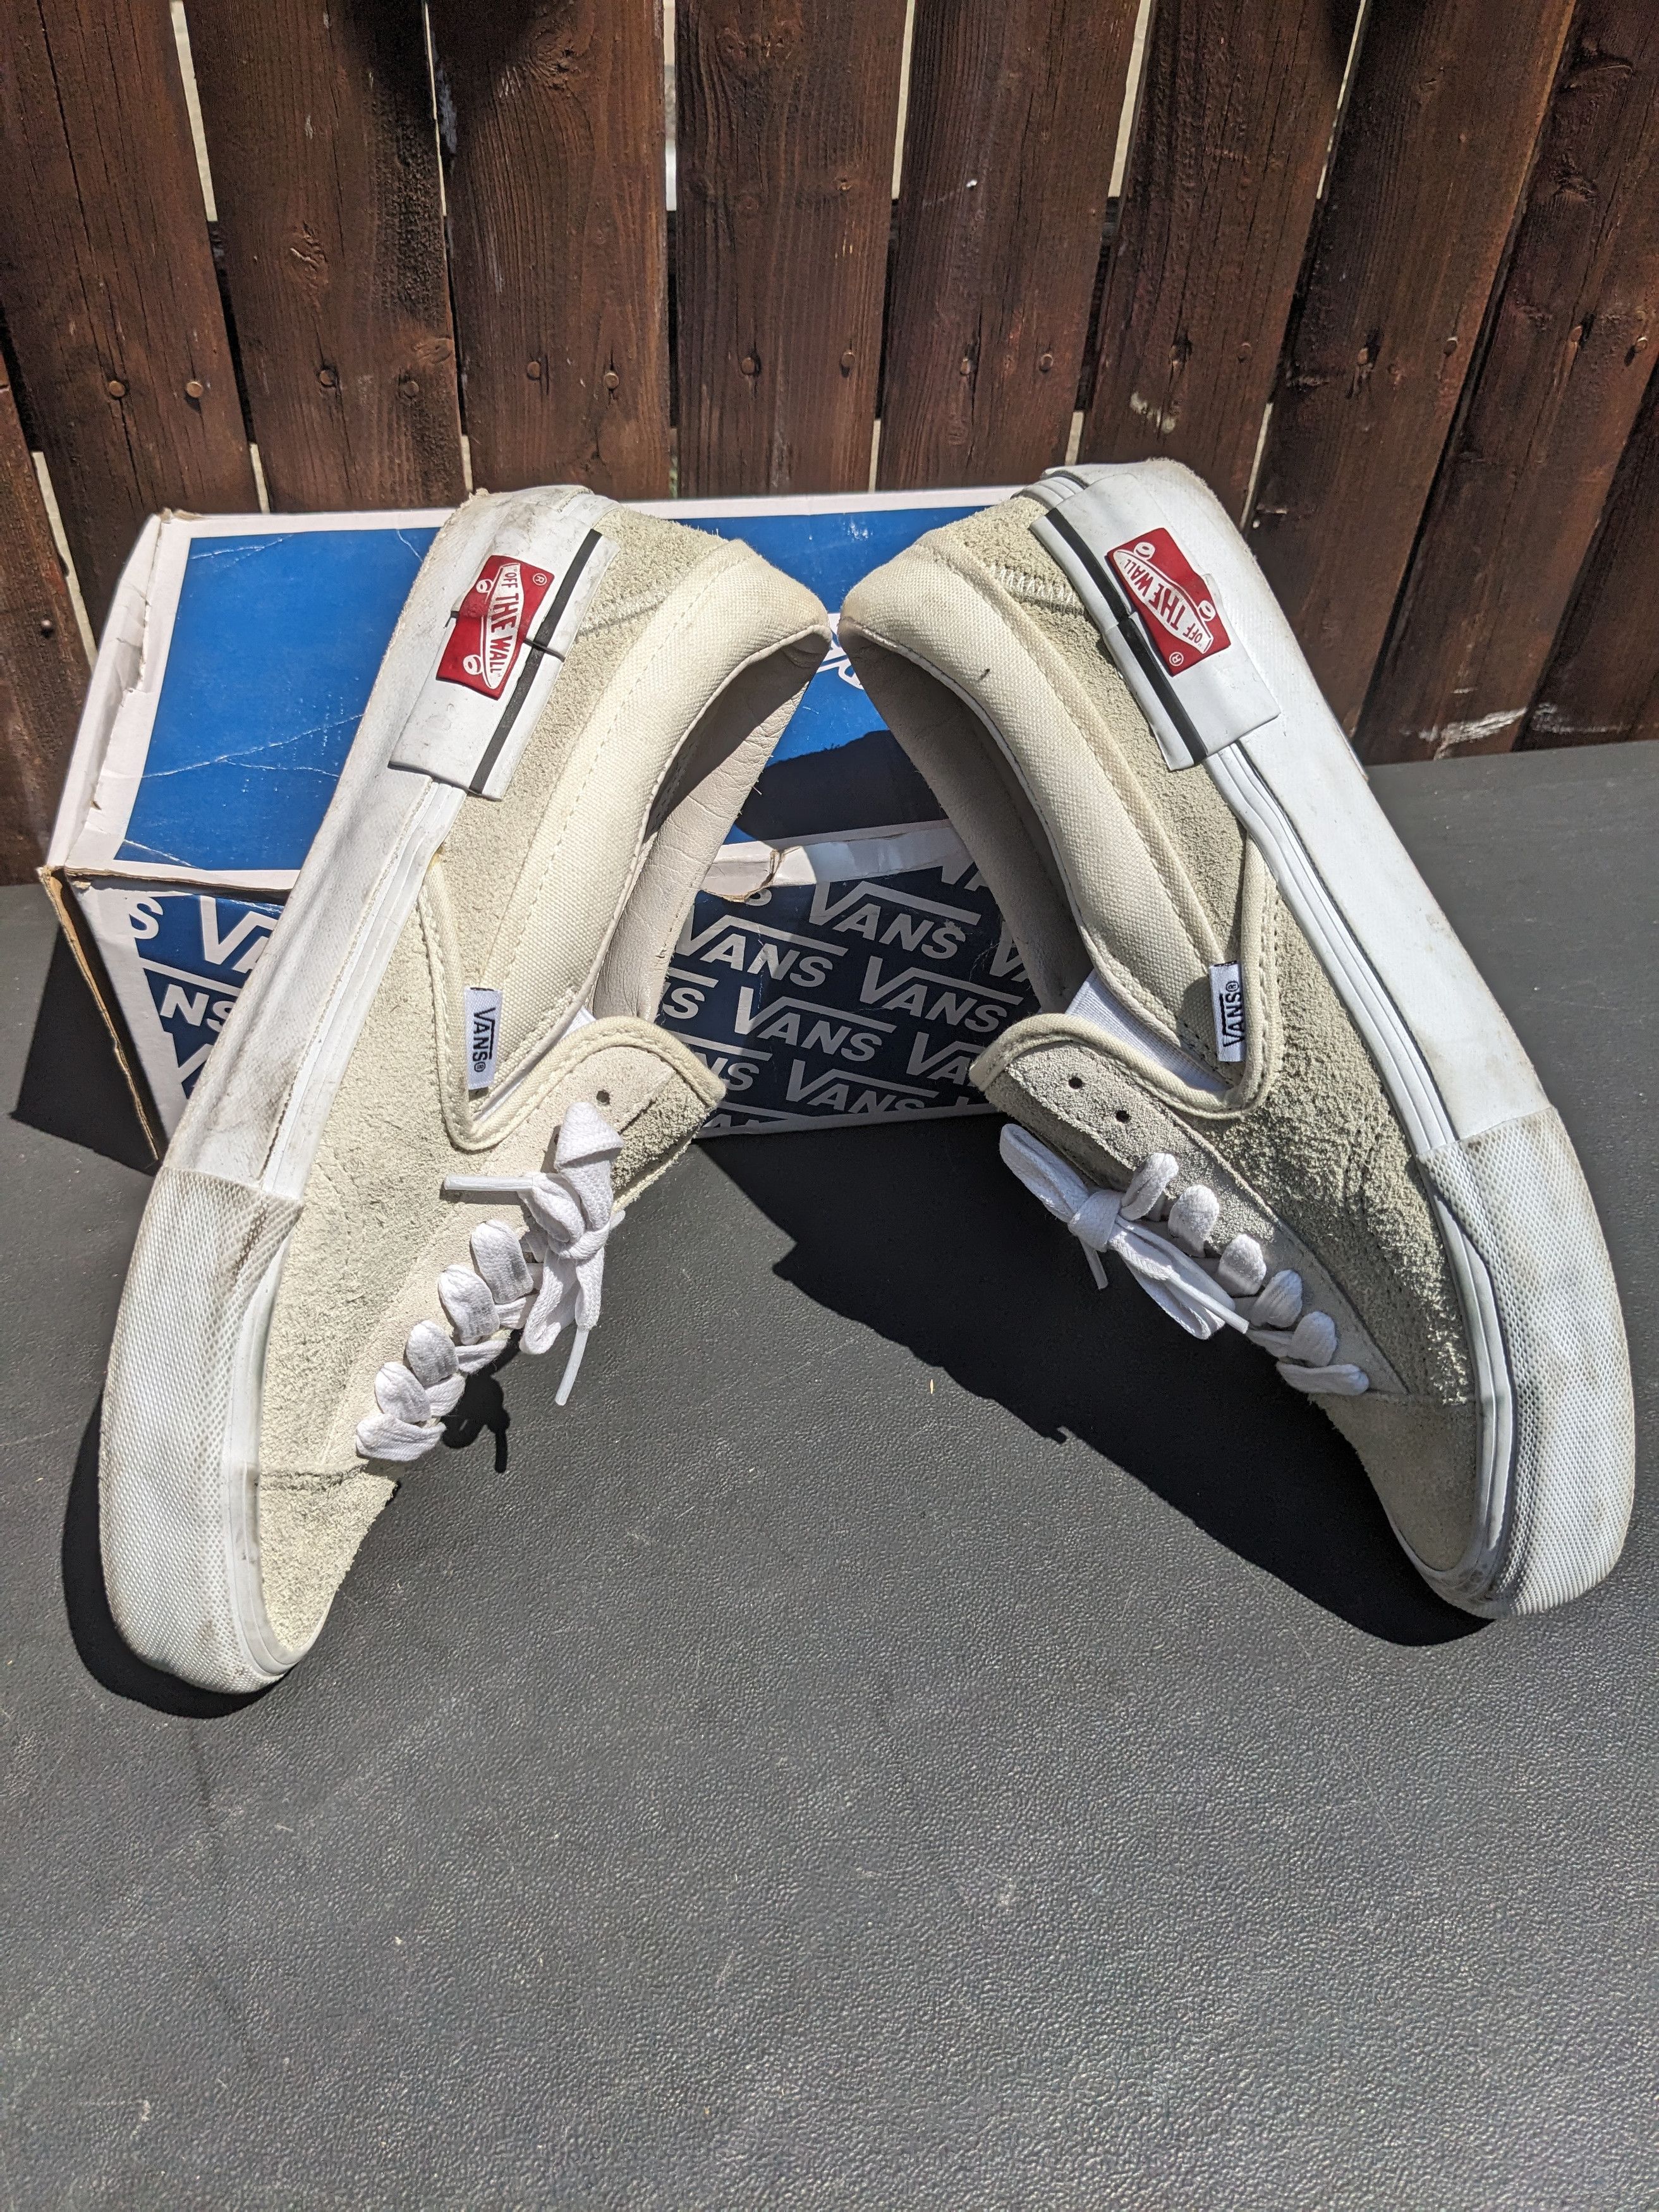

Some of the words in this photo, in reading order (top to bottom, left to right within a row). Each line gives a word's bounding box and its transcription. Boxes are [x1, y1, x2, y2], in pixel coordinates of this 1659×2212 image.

[491, 593, 520, 633] THE
[1148, 583, 1186, 631] THE
[676, 905, 849, 987] VANS
[809, 880, 981, 959] VANS
[734, 986, 897, 1062] VANS
[860, 955, 1024, 1033] VANS
[906, 1031, 984, 1085] VA
